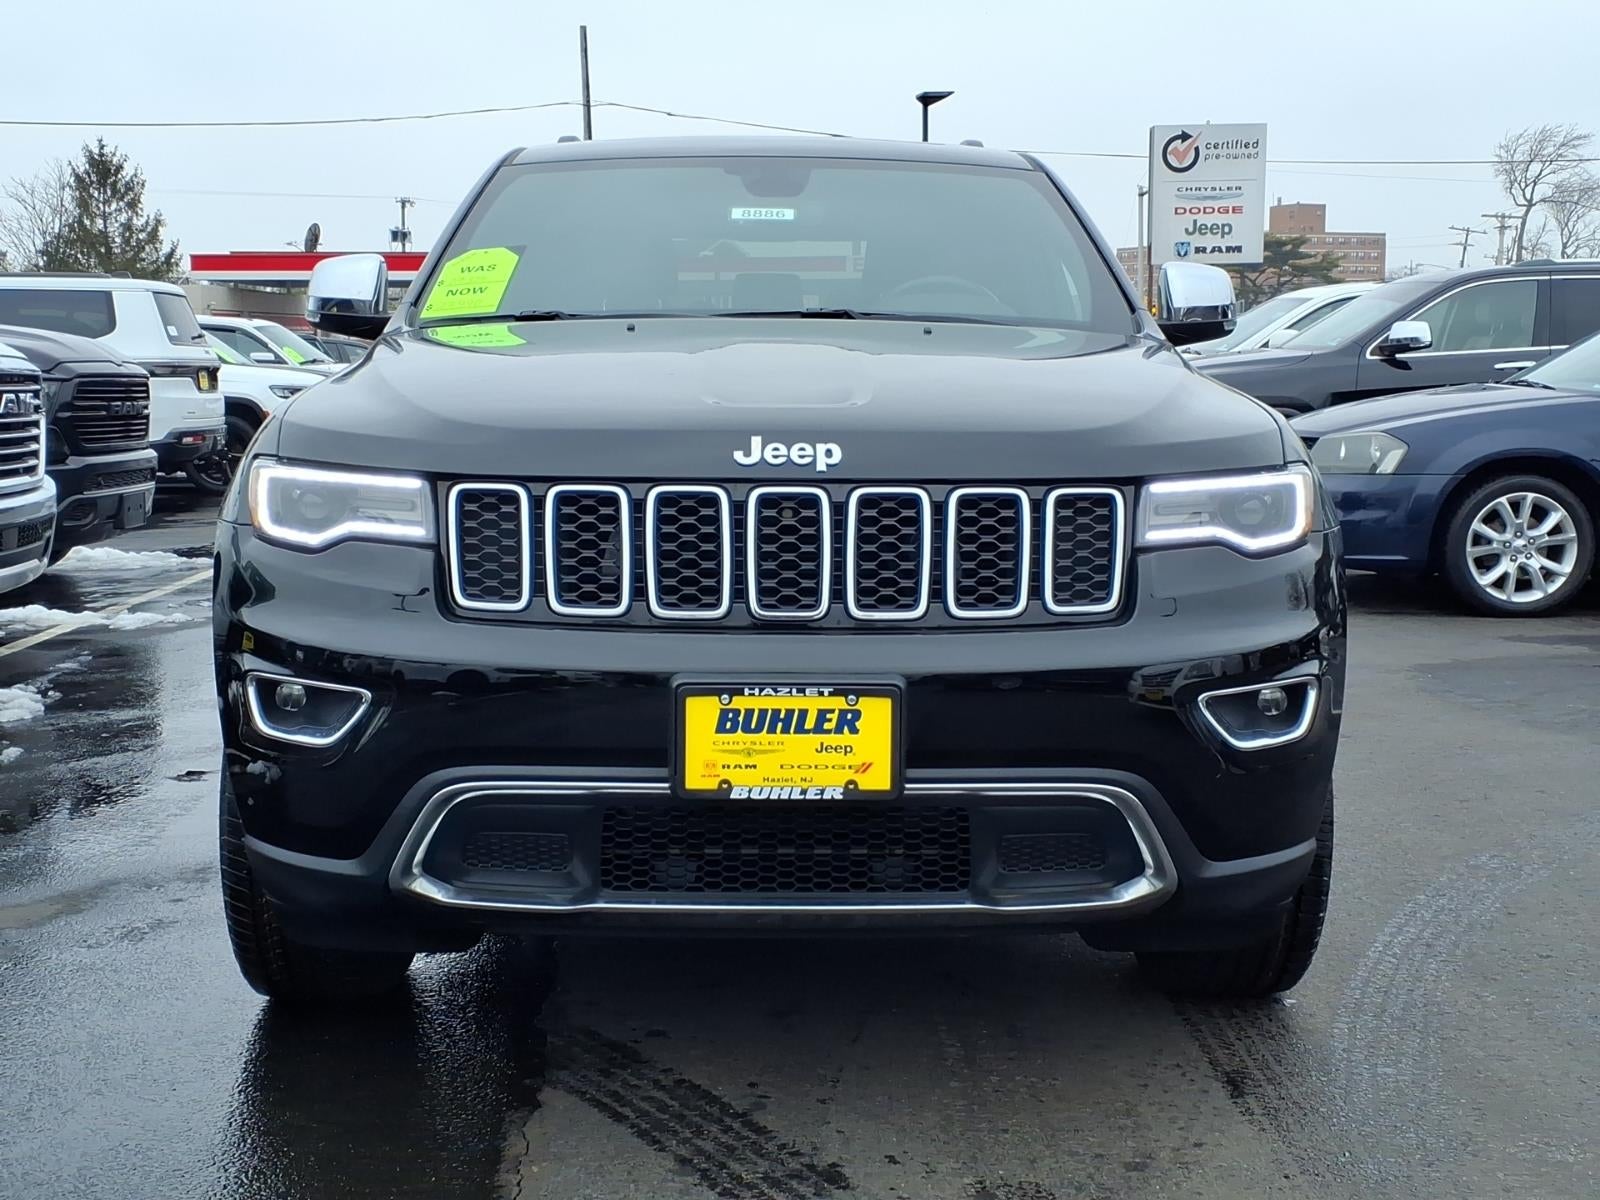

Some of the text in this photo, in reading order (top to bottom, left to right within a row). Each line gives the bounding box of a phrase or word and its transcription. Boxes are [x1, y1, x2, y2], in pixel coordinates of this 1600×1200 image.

[1205, 138, 1259, 150] certified
[1204, 151, 1259, 162] pre-owned
[742, 209, 785, 218] 8886
[1174, 206, 1244, 215] DODGE
[1184, 219, 1233, 239] Jeep
[1194, 245, 1242, 254] RAM
[460, 264, 496, 273] WAS
[446, 287, 488, 297] NOW
[733, 435, 842, 472] Jeep
[743, 687, 834, 696] HAZLET
[715, 708, 862, 735] BUHLER
[815, 741, 853, 756] Jeep
[730, 785, 844, 800] BUHLER
